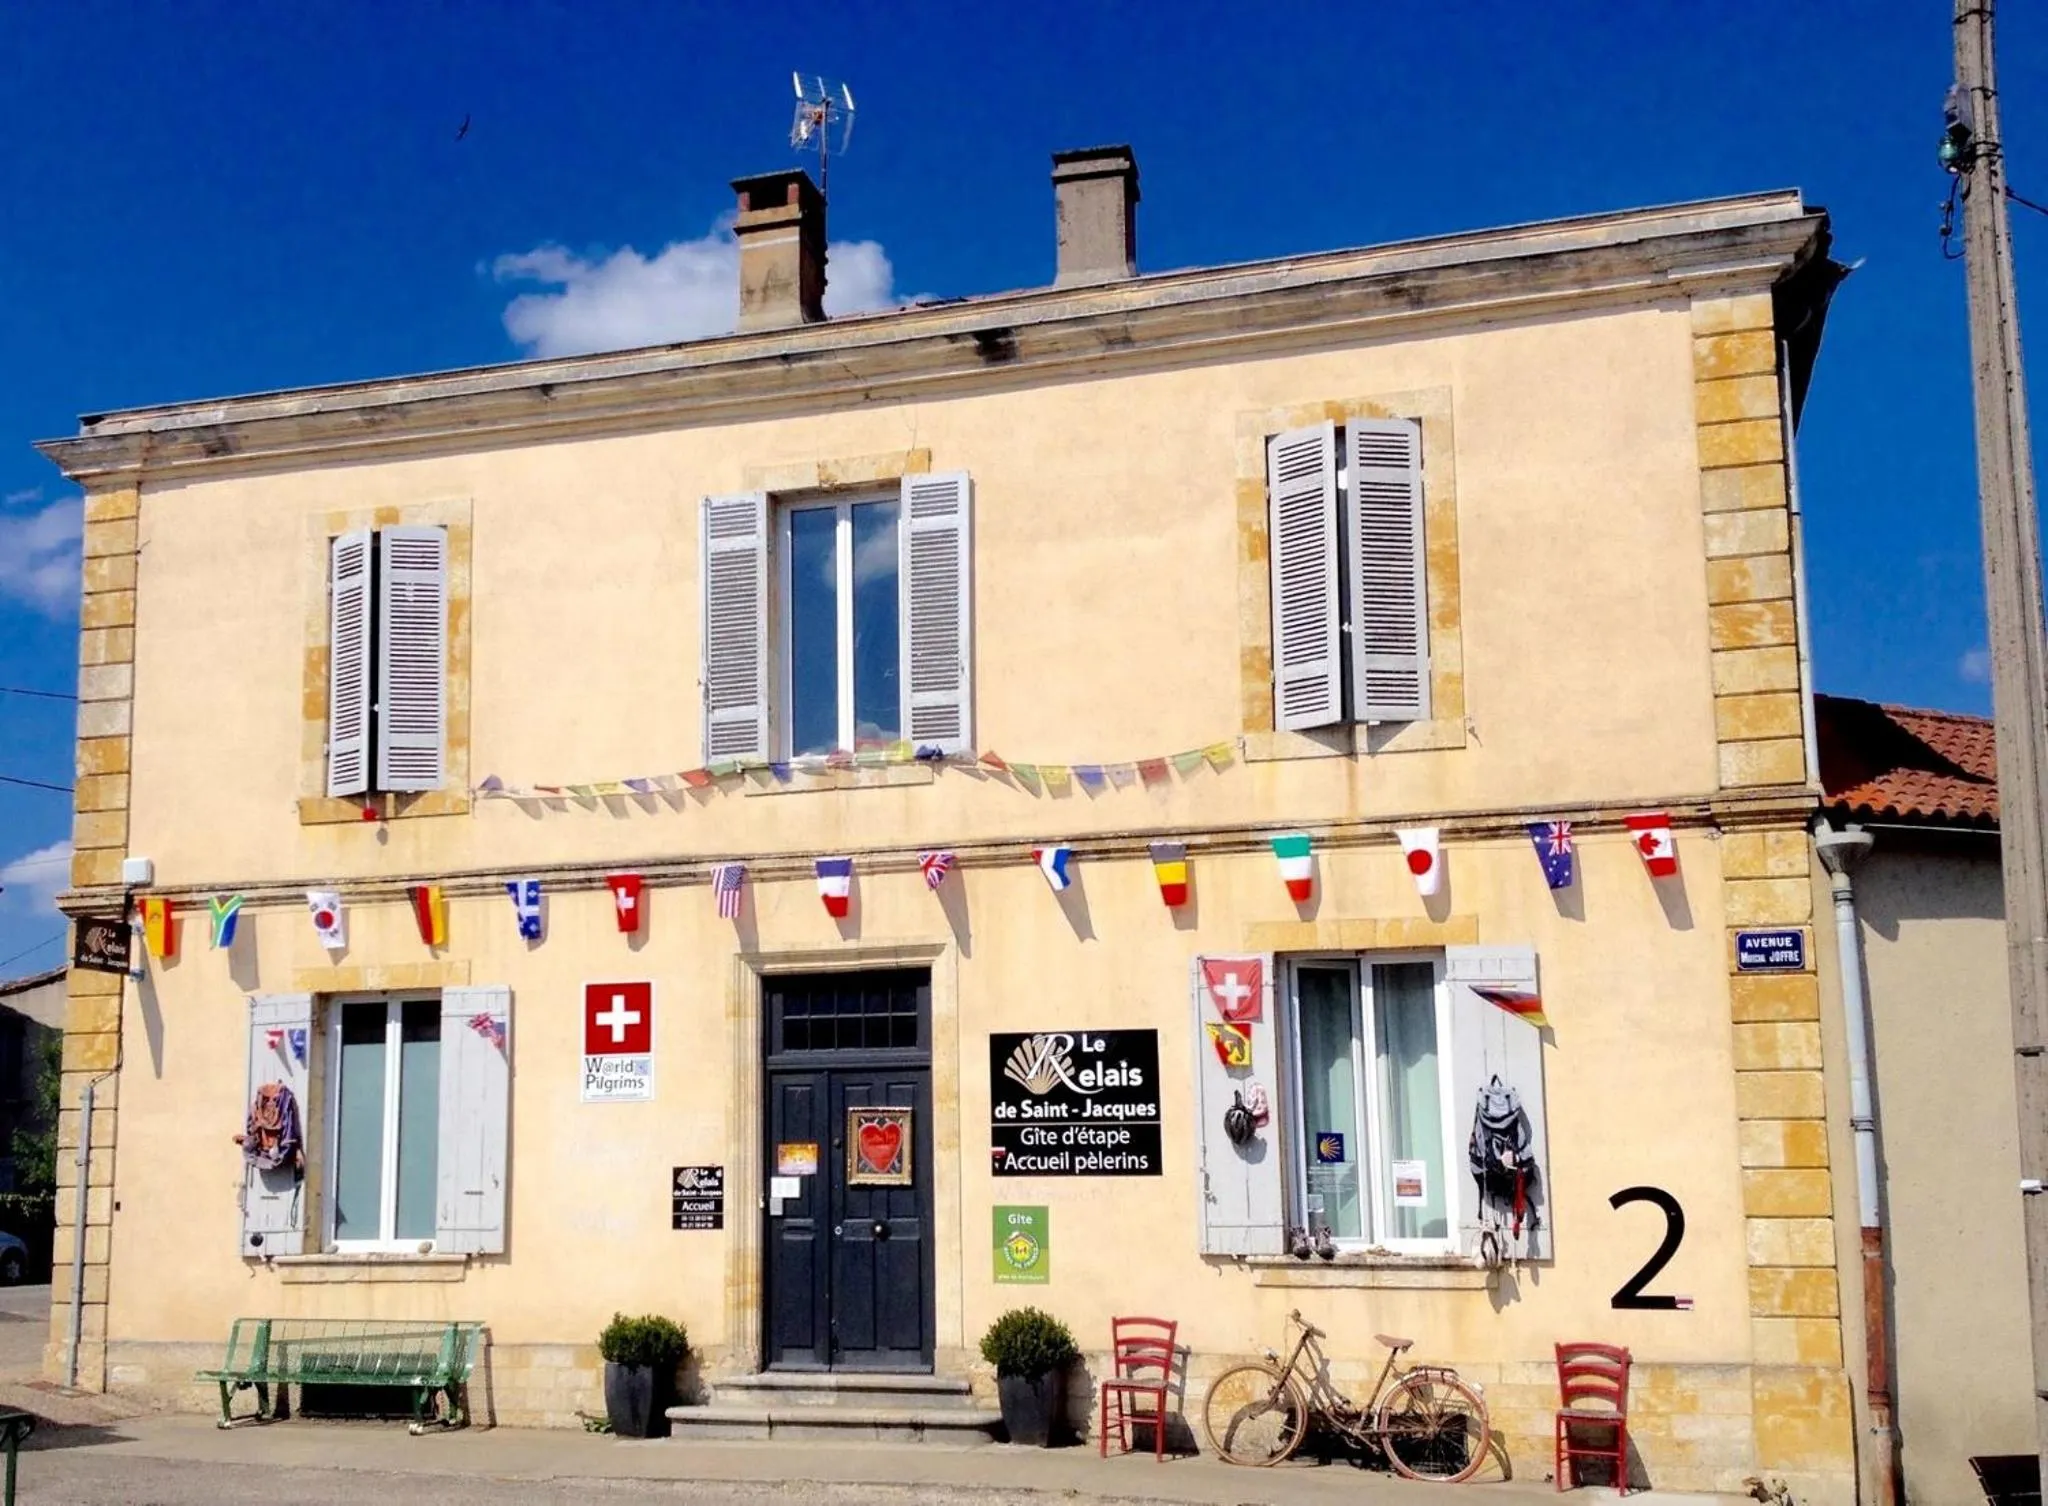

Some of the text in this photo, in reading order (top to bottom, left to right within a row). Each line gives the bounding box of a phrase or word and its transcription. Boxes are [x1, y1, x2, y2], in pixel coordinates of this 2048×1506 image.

[1745, 936, 1793, 949] AVENUE
[1769, 950, 1800, 962] JOFFRE
[1081, 1034, 1106, 1053] Le
[585, 1056, 634, 1076] W@rld
[1026, 1033, 1143, 1094] Relais
[586, 1073, 645, 1093] Pilgrims
[994, 1101, 1017, 1119] de
[1021, 1099, 1068, 1119] Saint
[1082, 1098, 1156, 1120] Jacques
[1020, 1126, 1058, 1145] Gîte
[1004, 1151, 1149, 1175] Accueil pèlerins
[682, 1199, 715, 1212] Accueil
[1608, 1186, 1694, 1310] 2
